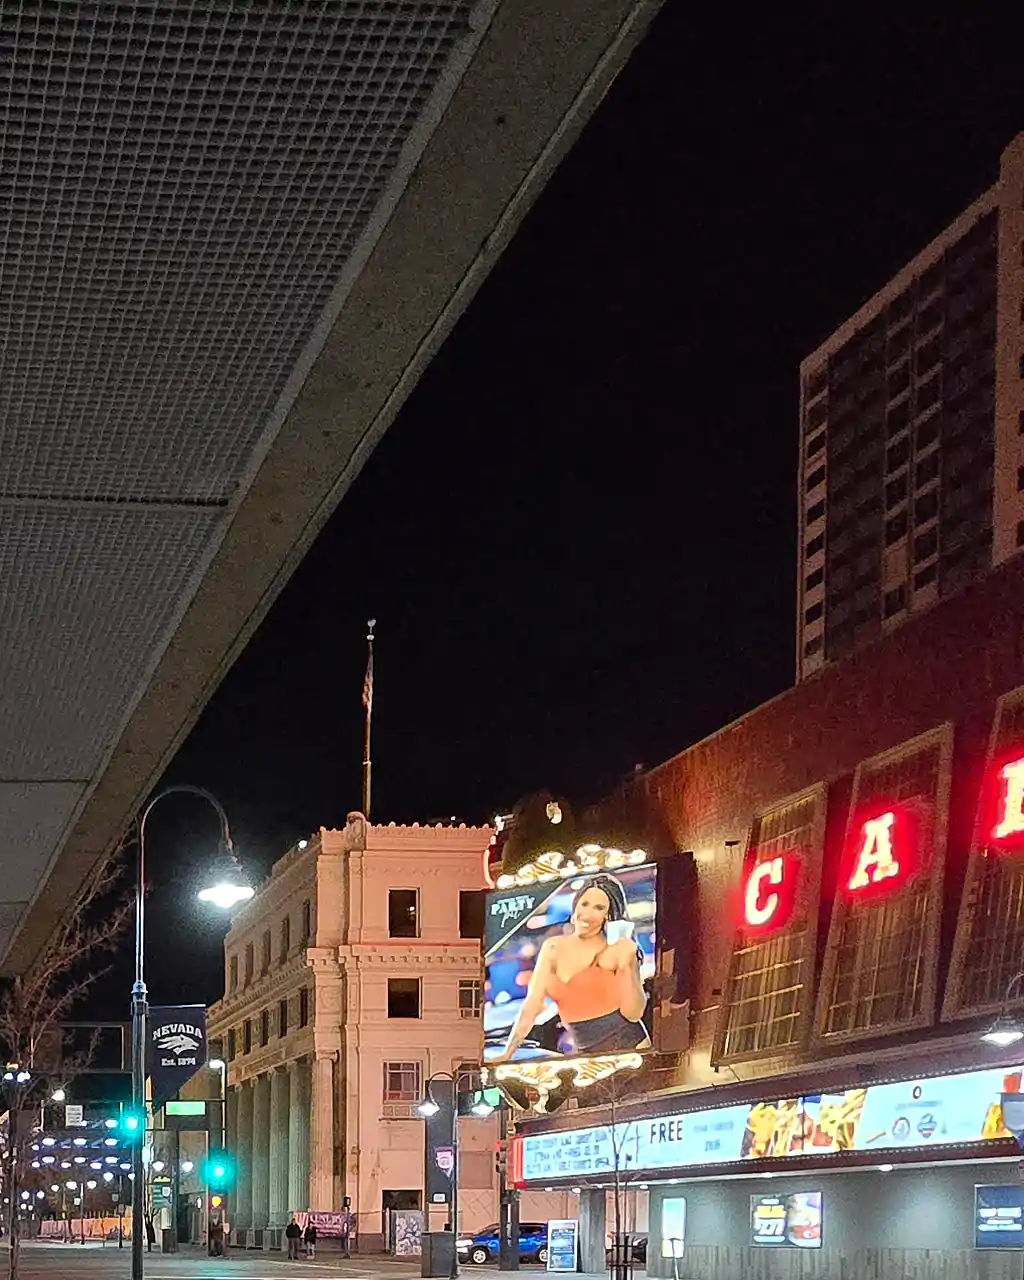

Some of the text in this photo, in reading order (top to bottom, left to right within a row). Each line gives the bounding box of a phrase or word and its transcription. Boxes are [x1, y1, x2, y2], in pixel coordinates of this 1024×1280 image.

[491, 895, 536, 916] PARTY
[152, 1023, 203, 1041] NEVADA
[649, 1119, 684, 1144] FREE
